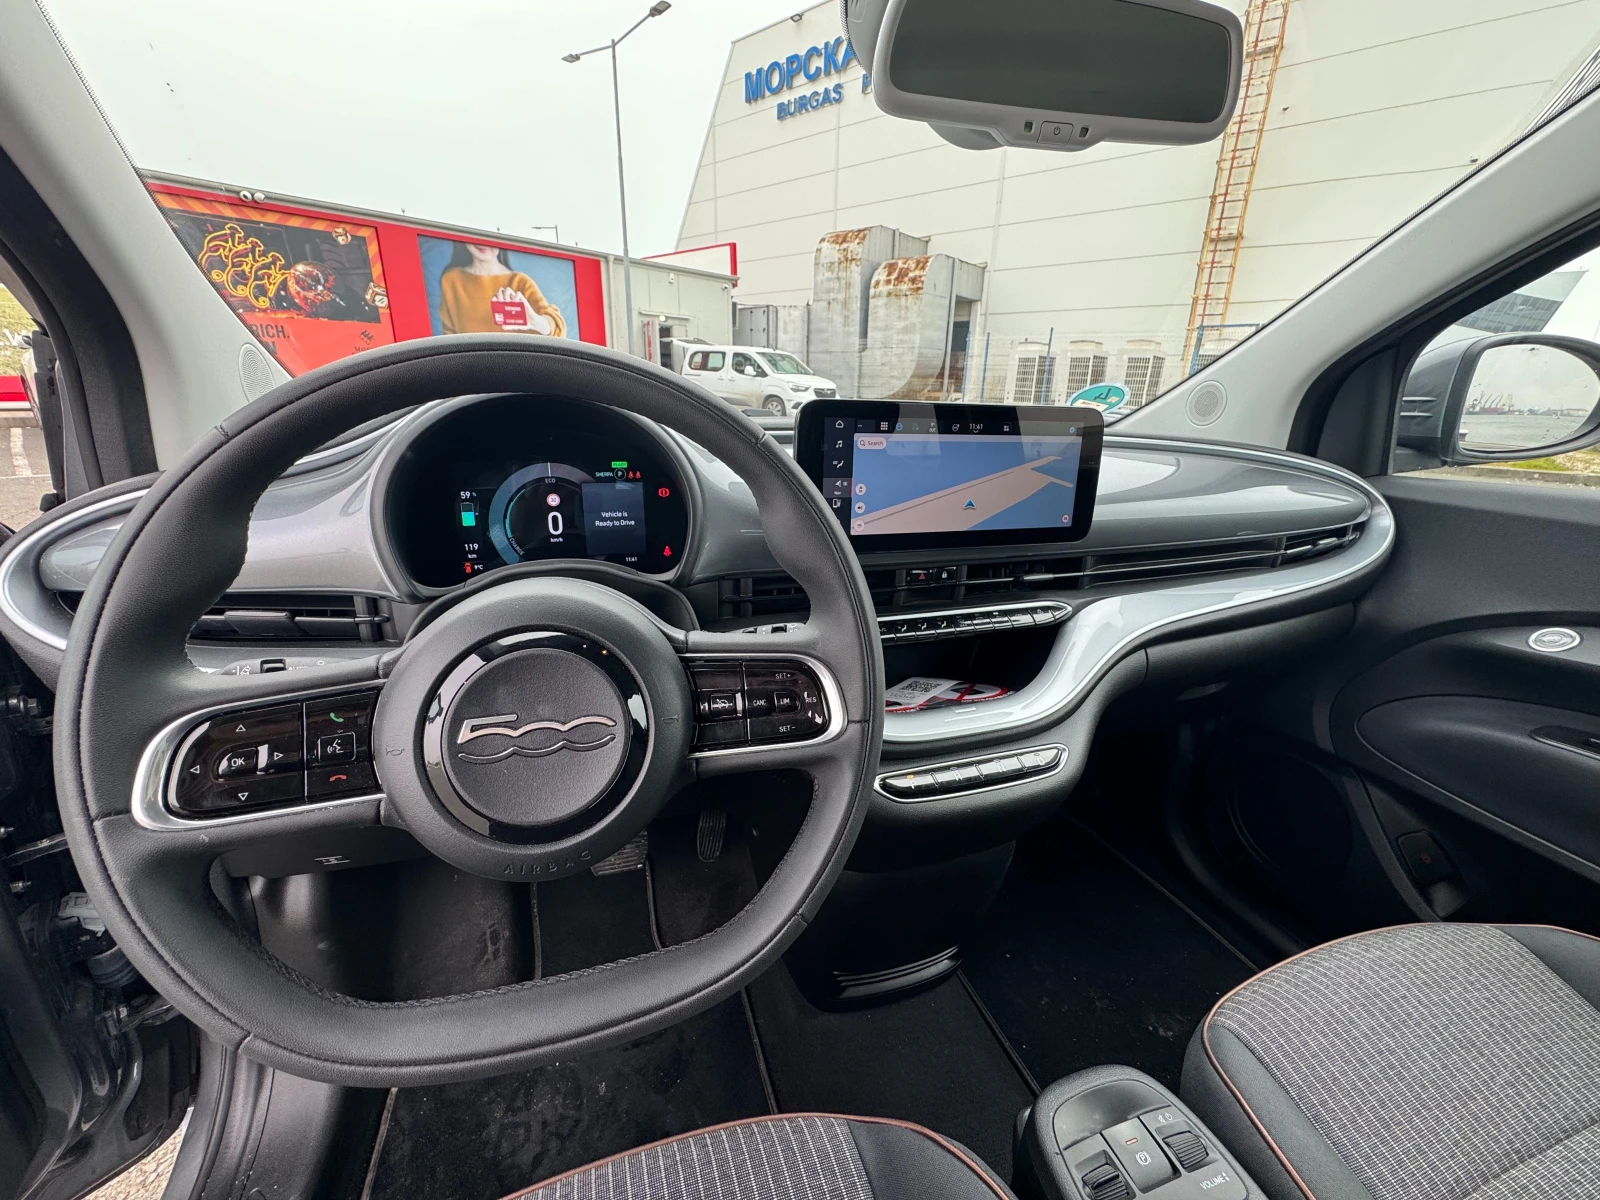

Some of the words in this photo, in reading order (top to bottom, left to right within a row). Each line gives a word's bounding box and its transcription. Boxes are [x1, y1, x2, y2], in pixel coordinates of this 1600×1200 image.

[777, 83, 843, 120] BURGAS
[460, 491, 471, 499] 59
[548, 511, 563, 535] 0
[464, 543, 478, 551] 119
[510, 537, 525, 556] CHARGE
[457, 713, 617, 765] 500
[231, 757, 245, 766] OK
[1037, 757, 1046, 765] D
[996, 764, 1006, 772] N
[953, 772, 963, 781] R
[910, 781, 916, 789] P
[504, 850, 591, 875] AIRBAG
[1200, 1174, 1226, 1190] VOLUME
